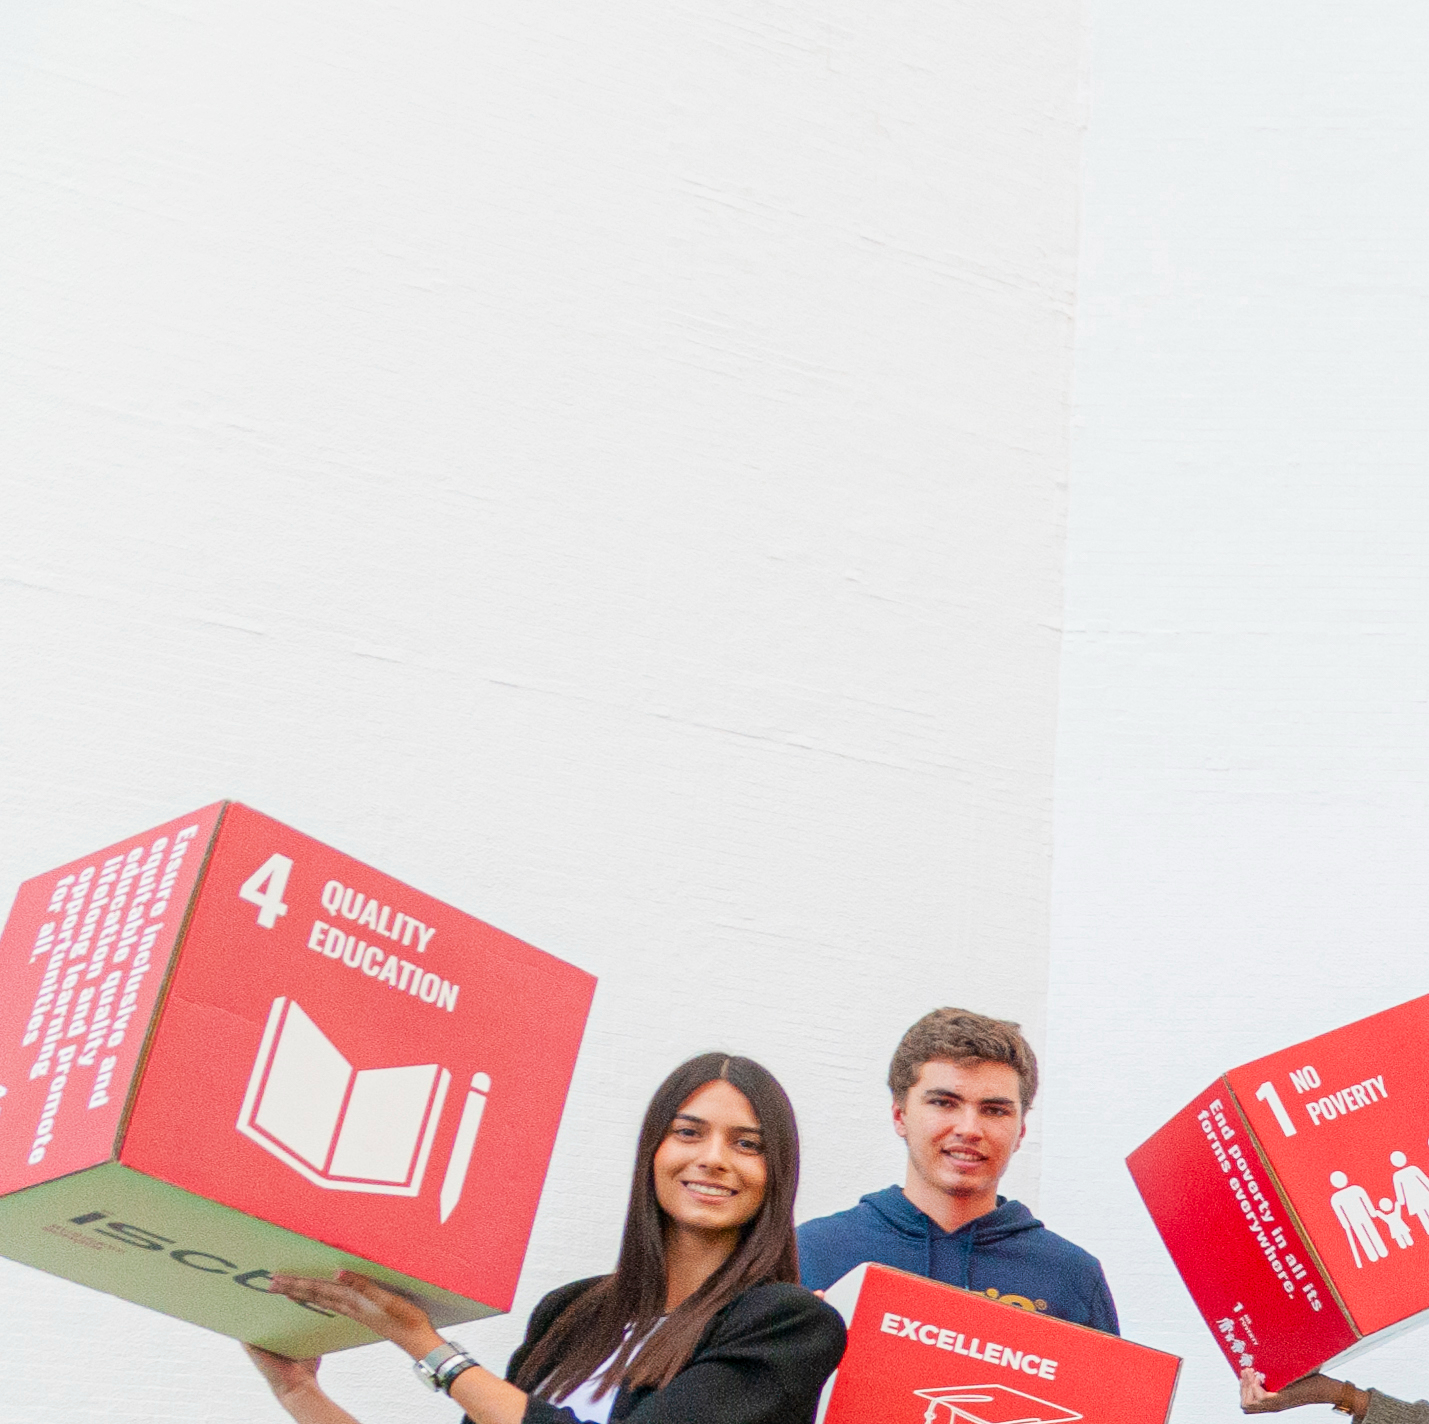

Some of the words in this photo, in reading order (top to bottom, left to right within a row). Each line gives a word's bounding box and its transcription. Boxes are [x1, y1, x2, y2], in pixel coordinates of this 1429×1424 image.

[47, 873, 75, 914] for
[68, 854, 125, 960] lifelong
[85, 846, 143, 980] education
[113, 837, 169, 964] equitable
[150, 825, 199, 918] Ensure
[238, 853, 294, 930] 4
[320, 879, 436, 953] QUALITY
[22, 865, 96, 1047] opportunities
[107, 922, 164, 1048] inclusive
[307, 919, 460, 1013] EDUCATION
[29, 962, 87, 1080] learning
[67, 986, 96, 1039] and
[77, 970, 122, 1067] quality
[27, 1044, 77, 1165] promote
[88, 1055, 117, 1110] and
[1255, 1081, 1297, 1138] 1
[1289, 1065, 1321, 1094] NO
[1306, 1075, 1389, 1126] POVERTY
[1198, 1109, 1231, 1173] forms
[1229, 1177, 1295, 1300] everywhere.
[1209, 1099, 1236, 1140] End
[1228, 1144, 1274, 1223] poverty
[1271, 1226, 1287, 1249] in
[1285, 1253, 1307, 1280] all
[1302, 1282, 1322, 1312] its
[881, 1312, 1058, 1381] EXCELLENCE
